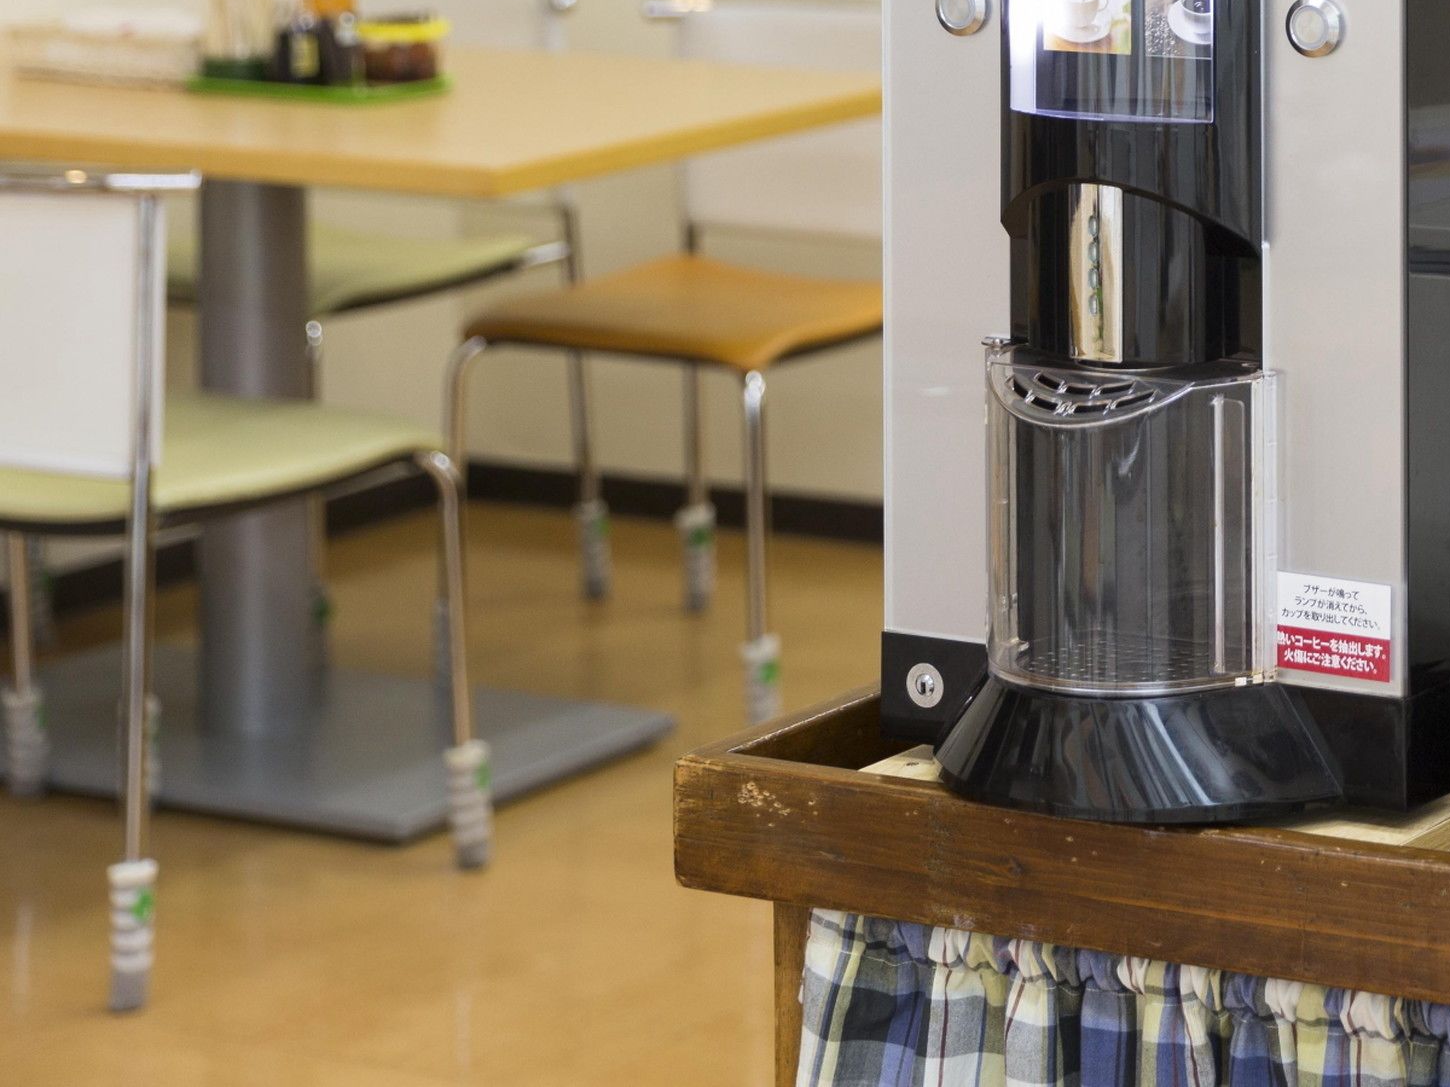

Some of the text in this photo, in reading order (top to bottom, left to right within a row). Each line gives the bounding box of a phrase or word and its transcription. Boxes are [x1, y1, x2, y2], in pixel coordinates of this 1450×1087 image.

[1303, 584, 1360, 601] ブザーが鳴って
[1295, 596, 1369, 615] ランプが消えてから、
[1281, 608, 1381, 631] カップを取り出してください。
[1283, 648, 1378, 674] 火傷にご注意ください。
